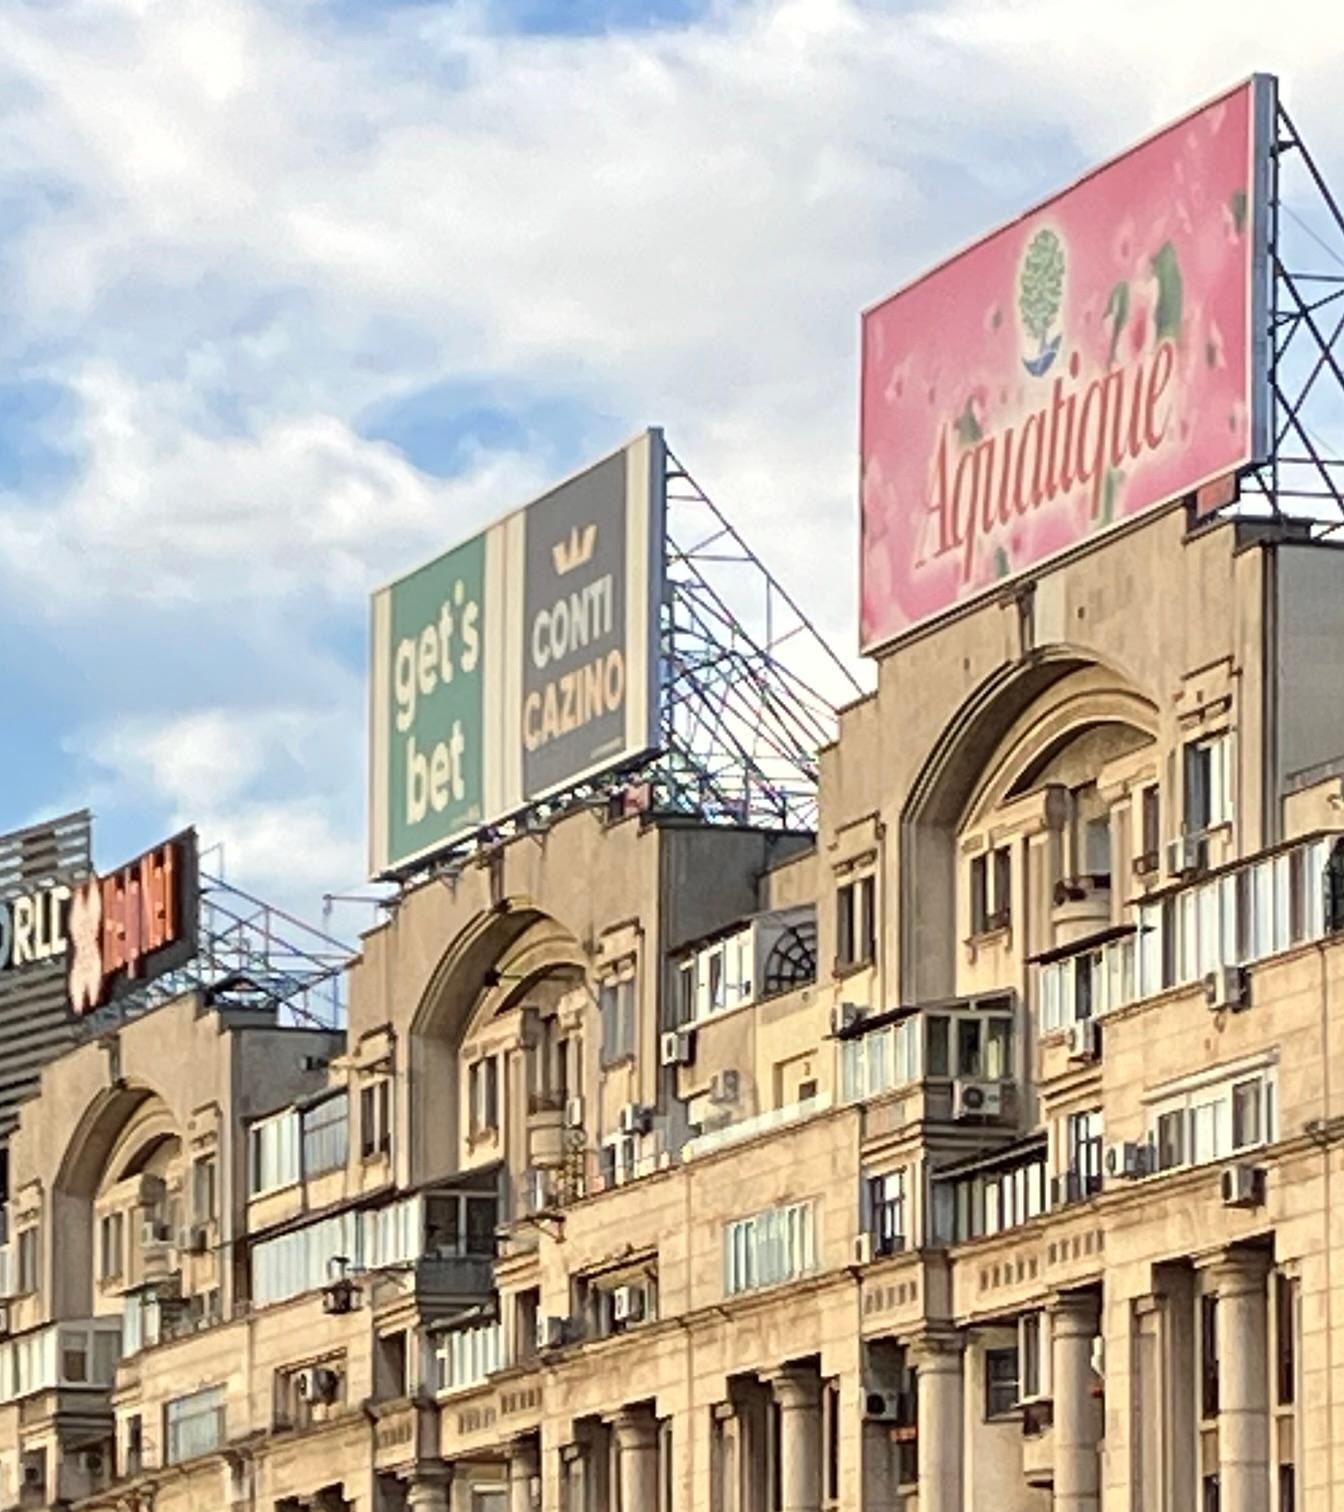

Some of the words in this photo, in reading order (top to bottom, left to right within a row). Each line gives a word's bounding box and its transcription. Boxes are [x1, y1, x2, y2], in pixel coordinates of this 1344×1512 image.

[914, 342, 1175, 583] Aquatique
[394, 579, 481, 733] get's
[531, 573, 614, 671] CONTI
[522, 649, 626, 752] CAZINO
[405, 719, 466, 827] bet
